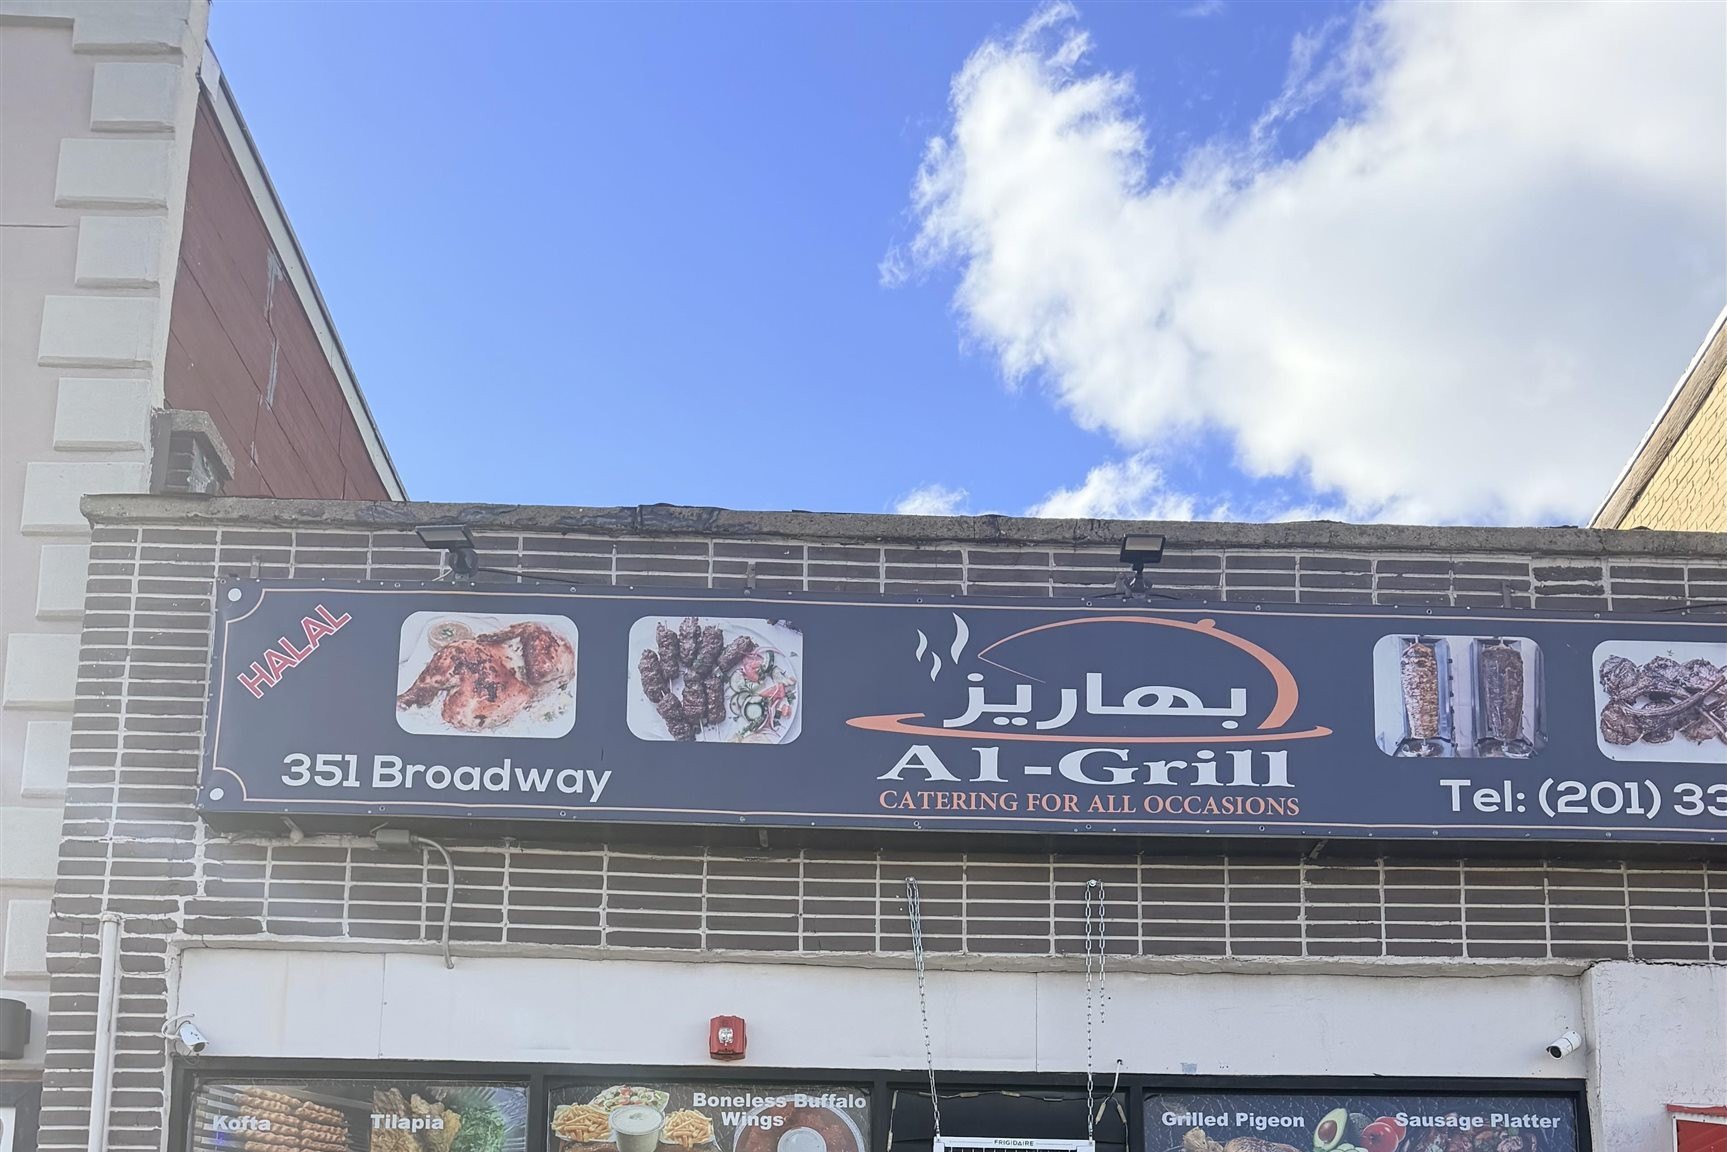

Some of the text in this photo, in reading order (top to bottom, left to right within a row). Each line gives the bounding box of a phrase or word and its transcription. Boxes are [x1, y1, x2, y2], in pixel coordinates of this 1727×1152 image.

[237, 604, 352, 699] HALAL
[943, 673, 1246, 730] بهاريز
[281, 753, 612, 803] 351 Broadway
[879, 790, 1300, 816] CATERING FOR ALL OCCASIONS
[1440, 779, 1526, 813] Tel:
[1539, 778, 1661, 819] (201)
[693, 1093, 867, 1109] Boneless Buffalo
[212, 1115, 271, 1131] Kofta
[370, 1114, 444, 1132] Tilapia
[721, 1112, 784, 1130] Wings
[1161, 1112, 1305, 1132] Grilled Pigeon
[1395, 1112, 1561, 1132] Sausage Platter
